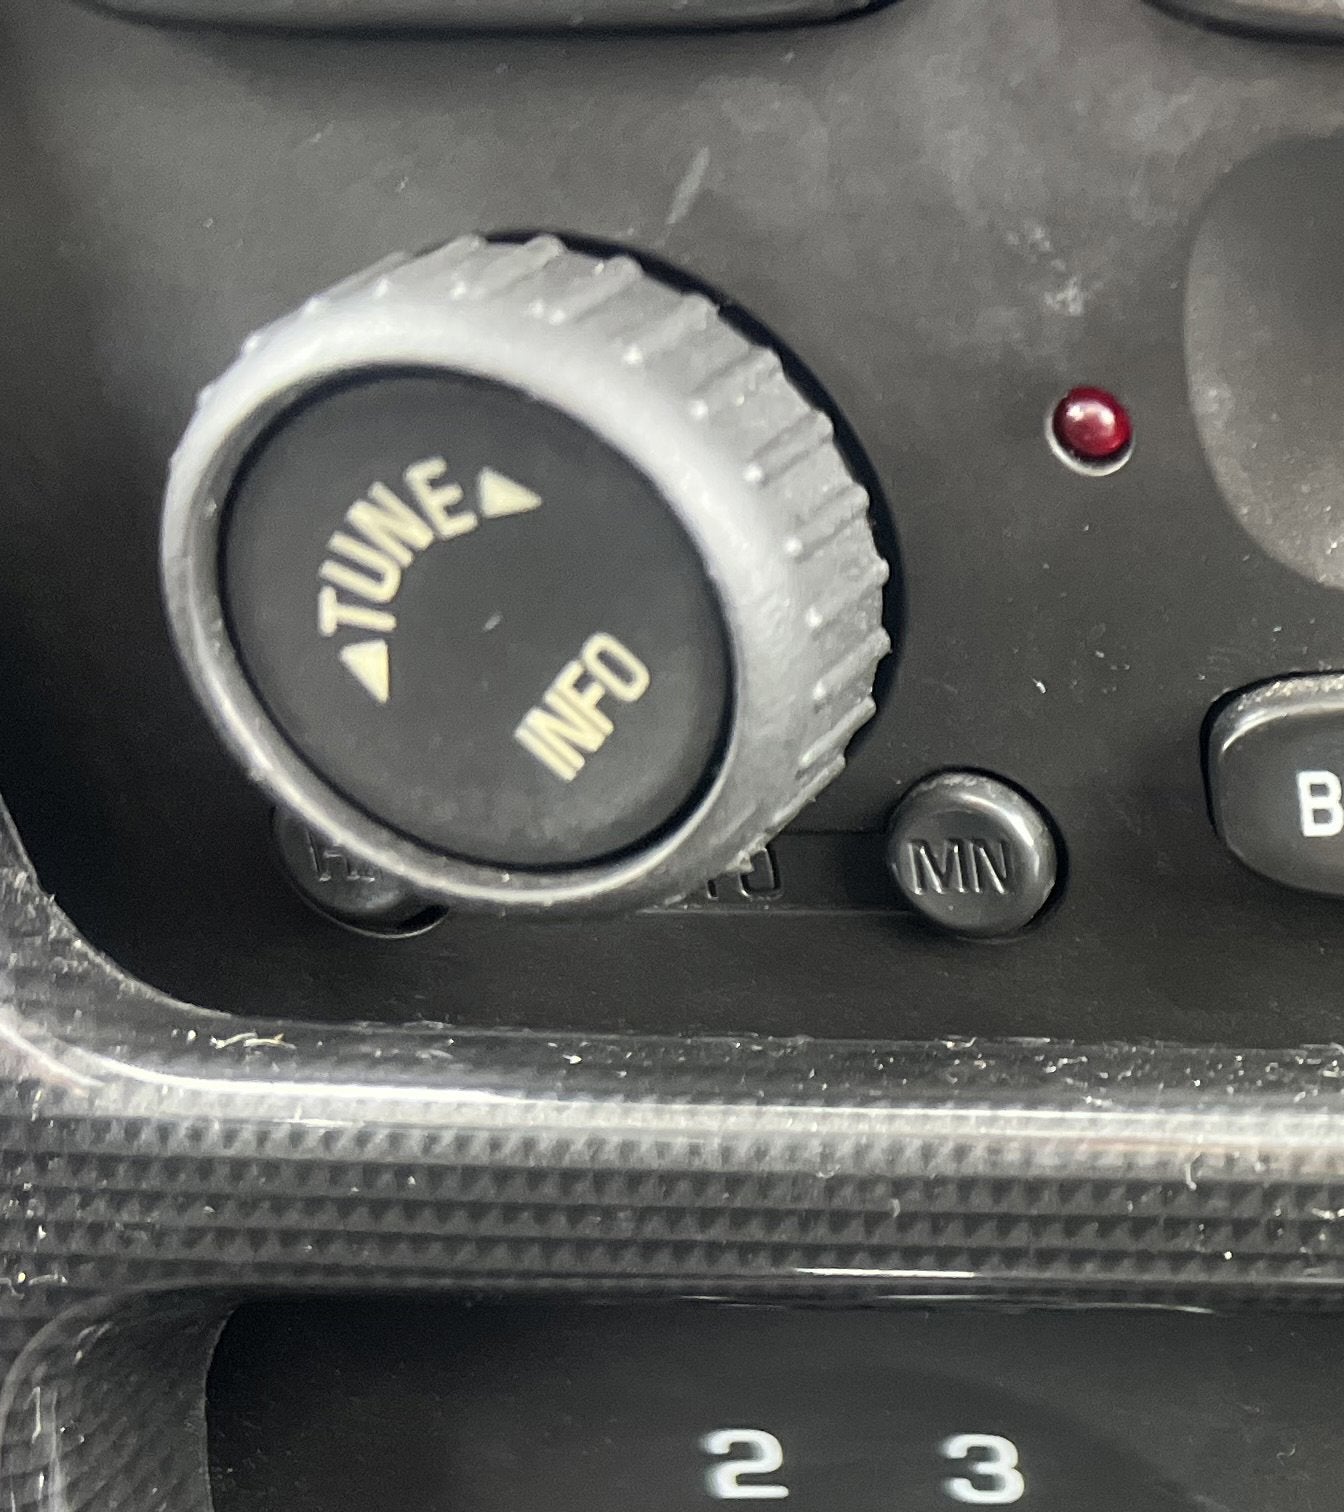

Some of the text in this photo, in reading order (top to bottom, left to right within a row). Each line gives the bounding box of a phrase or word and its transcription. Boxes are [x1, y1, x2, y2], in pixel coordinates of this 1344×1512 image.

[317, 454, 479, 638] TUNE
[513, 630, 651, 784] INFO
[702, 1427, 790, 1500] 2
[942, 1433, 1026, 1505] 3
